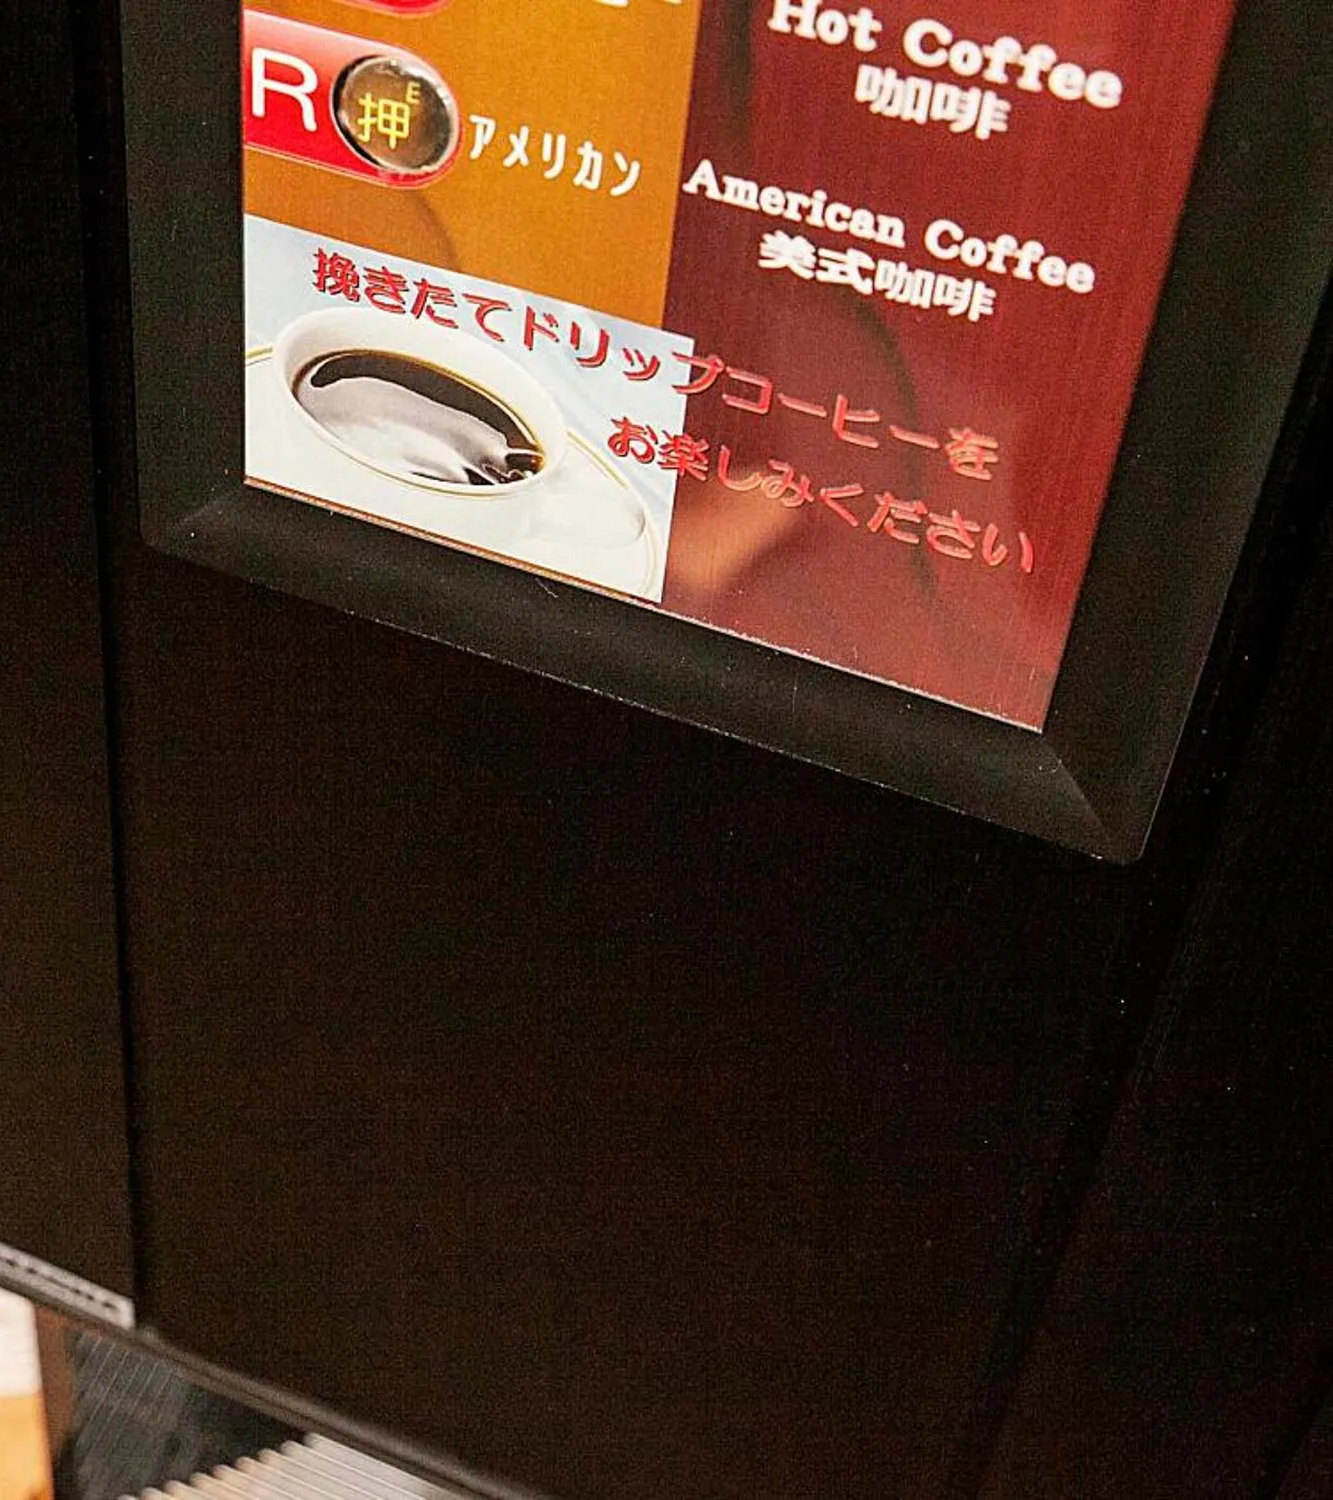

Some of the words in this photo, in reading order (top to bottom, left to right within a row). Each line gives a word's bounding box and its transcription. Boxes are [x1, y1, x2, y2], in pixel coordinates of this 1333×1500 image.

[251, 47, 318, 132] R
[768, 0, 882, 51] Hot
[903, 19, 1124, 108] Coffee
[357, 91, 411, 149] 押
[854, 64, 1011, 140] 咖啡
[468, 114, 641, 196] アメリカン
[683, 158, 906, 249] American
[924, 219, 1096, 294] Coffee
[758, 229, 997, 322] 美式咖啡
[313, 247, 999, 480] 挽きたてドリップコーヒーを
[607, 416, 1034, 574] お楽しみください
